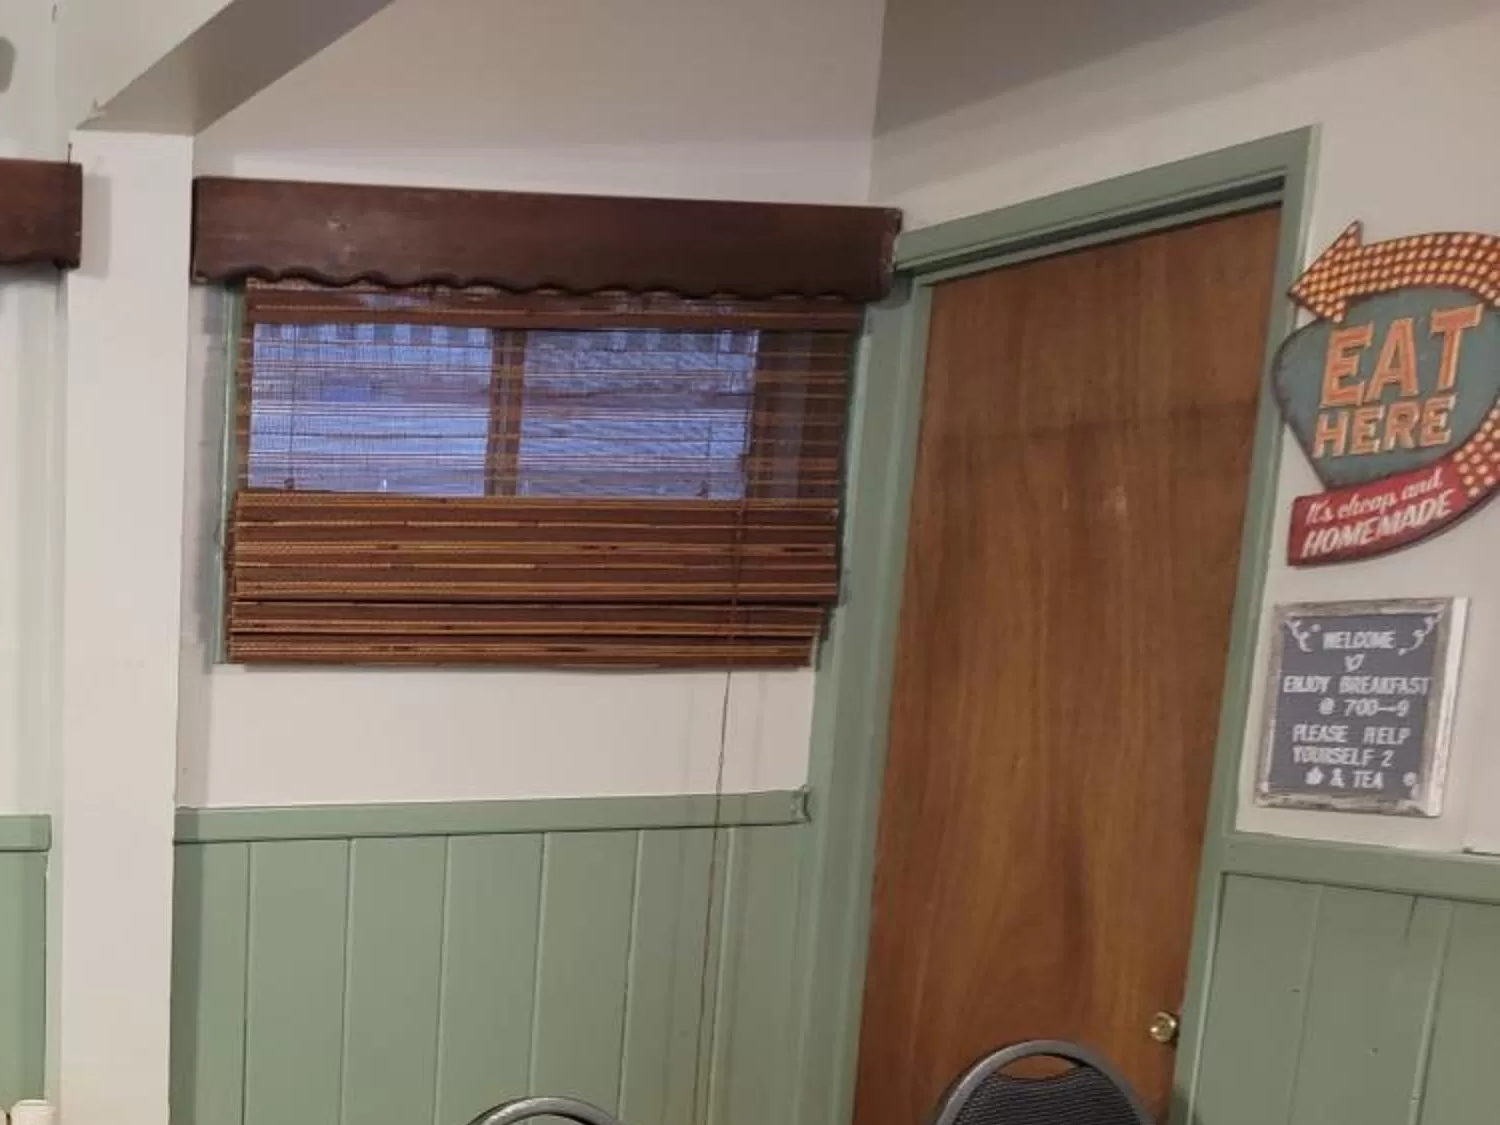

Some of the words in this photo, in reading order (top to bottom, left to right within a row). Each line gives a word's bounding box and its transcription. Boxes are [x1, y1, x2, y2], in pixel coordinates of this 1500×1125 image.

[1320, 304, 1484, 406] EAT
[1314, 395, 1454, 457] HERE
[1306, 500, 1334, 524] It's
[1401, 467, 1444, 500] and
[1302, 488, 1455, 556] HOMEMADE
[1323, 631, 1396, 649] WELCOME
[1283, 675, 1332, 692] ENJOY
[1339, 675, 1428, 696] BREAKFAST
[1293, 724, 1348, 743] PLEASE
[1364, 727, 1411, 745] HELP
[1293, 746, 1375, 767] YOURSELF
[1382, 750, 1395, 767] 2
[1353, 771, 1384, 789] TEA
